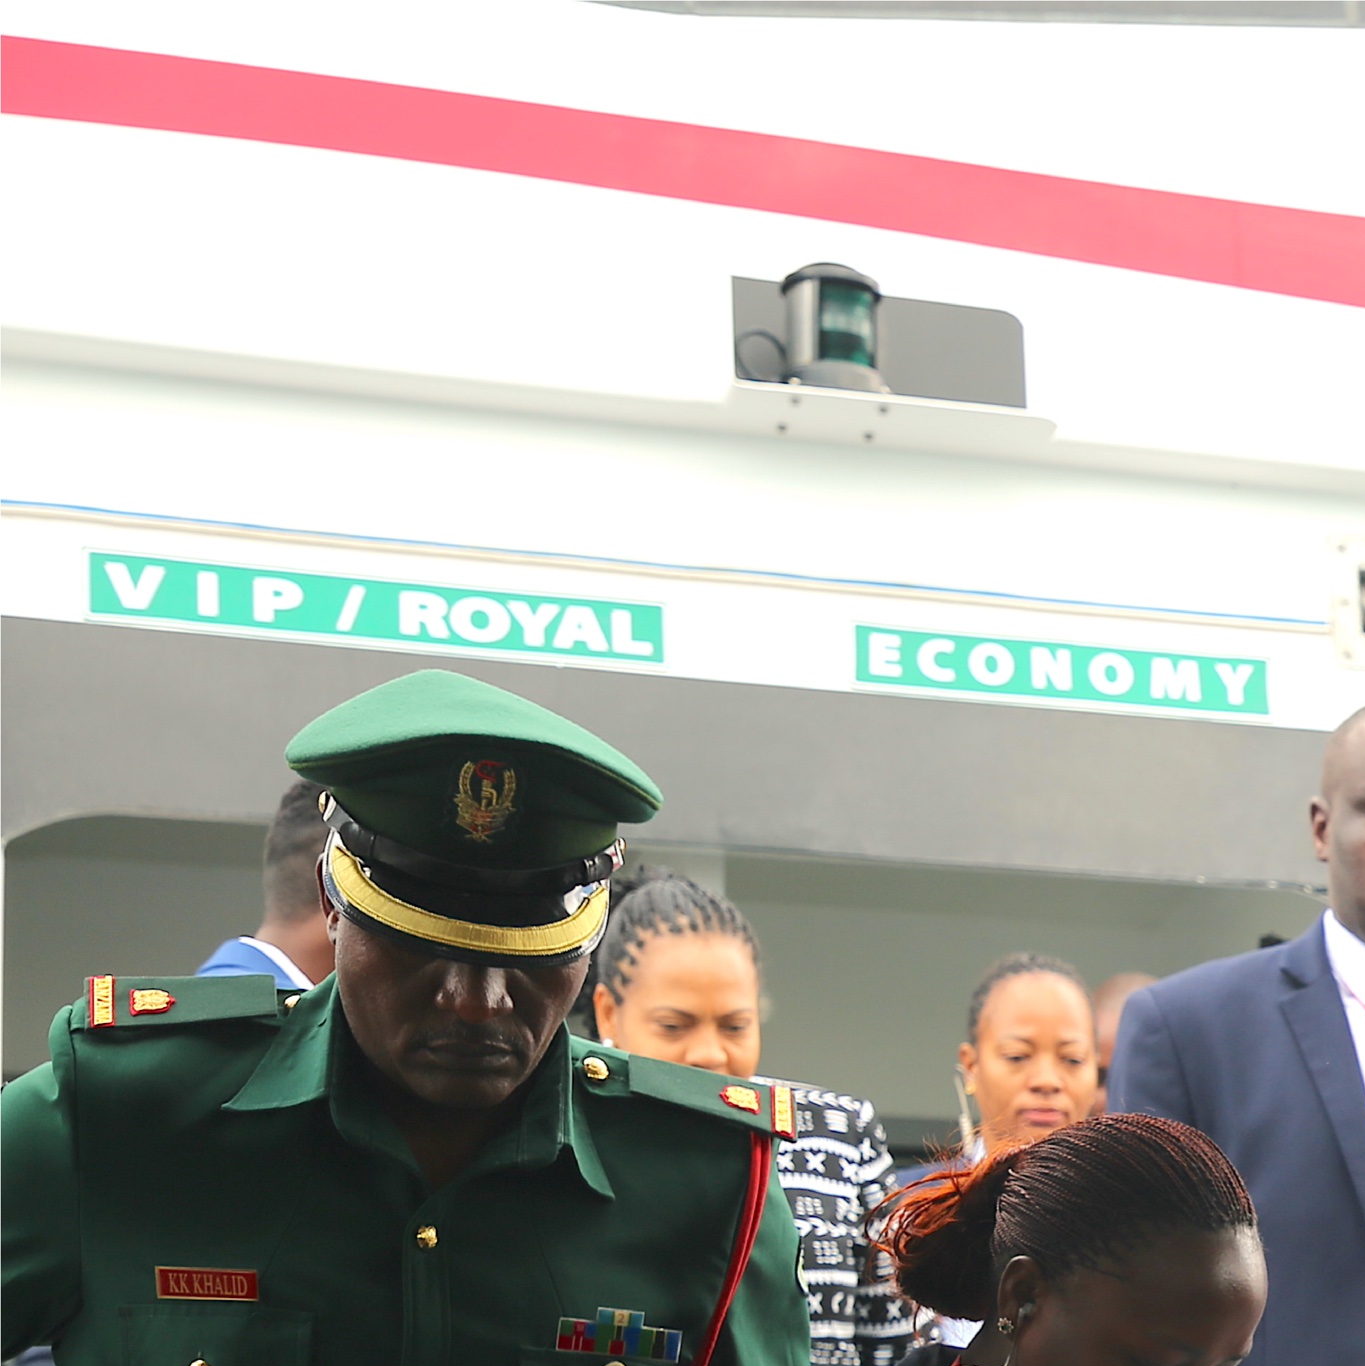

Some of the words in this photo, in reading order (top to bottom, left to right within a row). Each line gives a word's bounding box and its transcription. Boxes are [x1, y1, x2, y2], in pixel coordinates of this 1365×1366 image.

[104, 561, 304, 622] VIP
[399, 590, 655, 656] ROYAL
[867, 631, 1255, 706] ECONOMY
[168, 1272, 190, 1293] KK
[192, 1273, 248, 1296] KHALID
